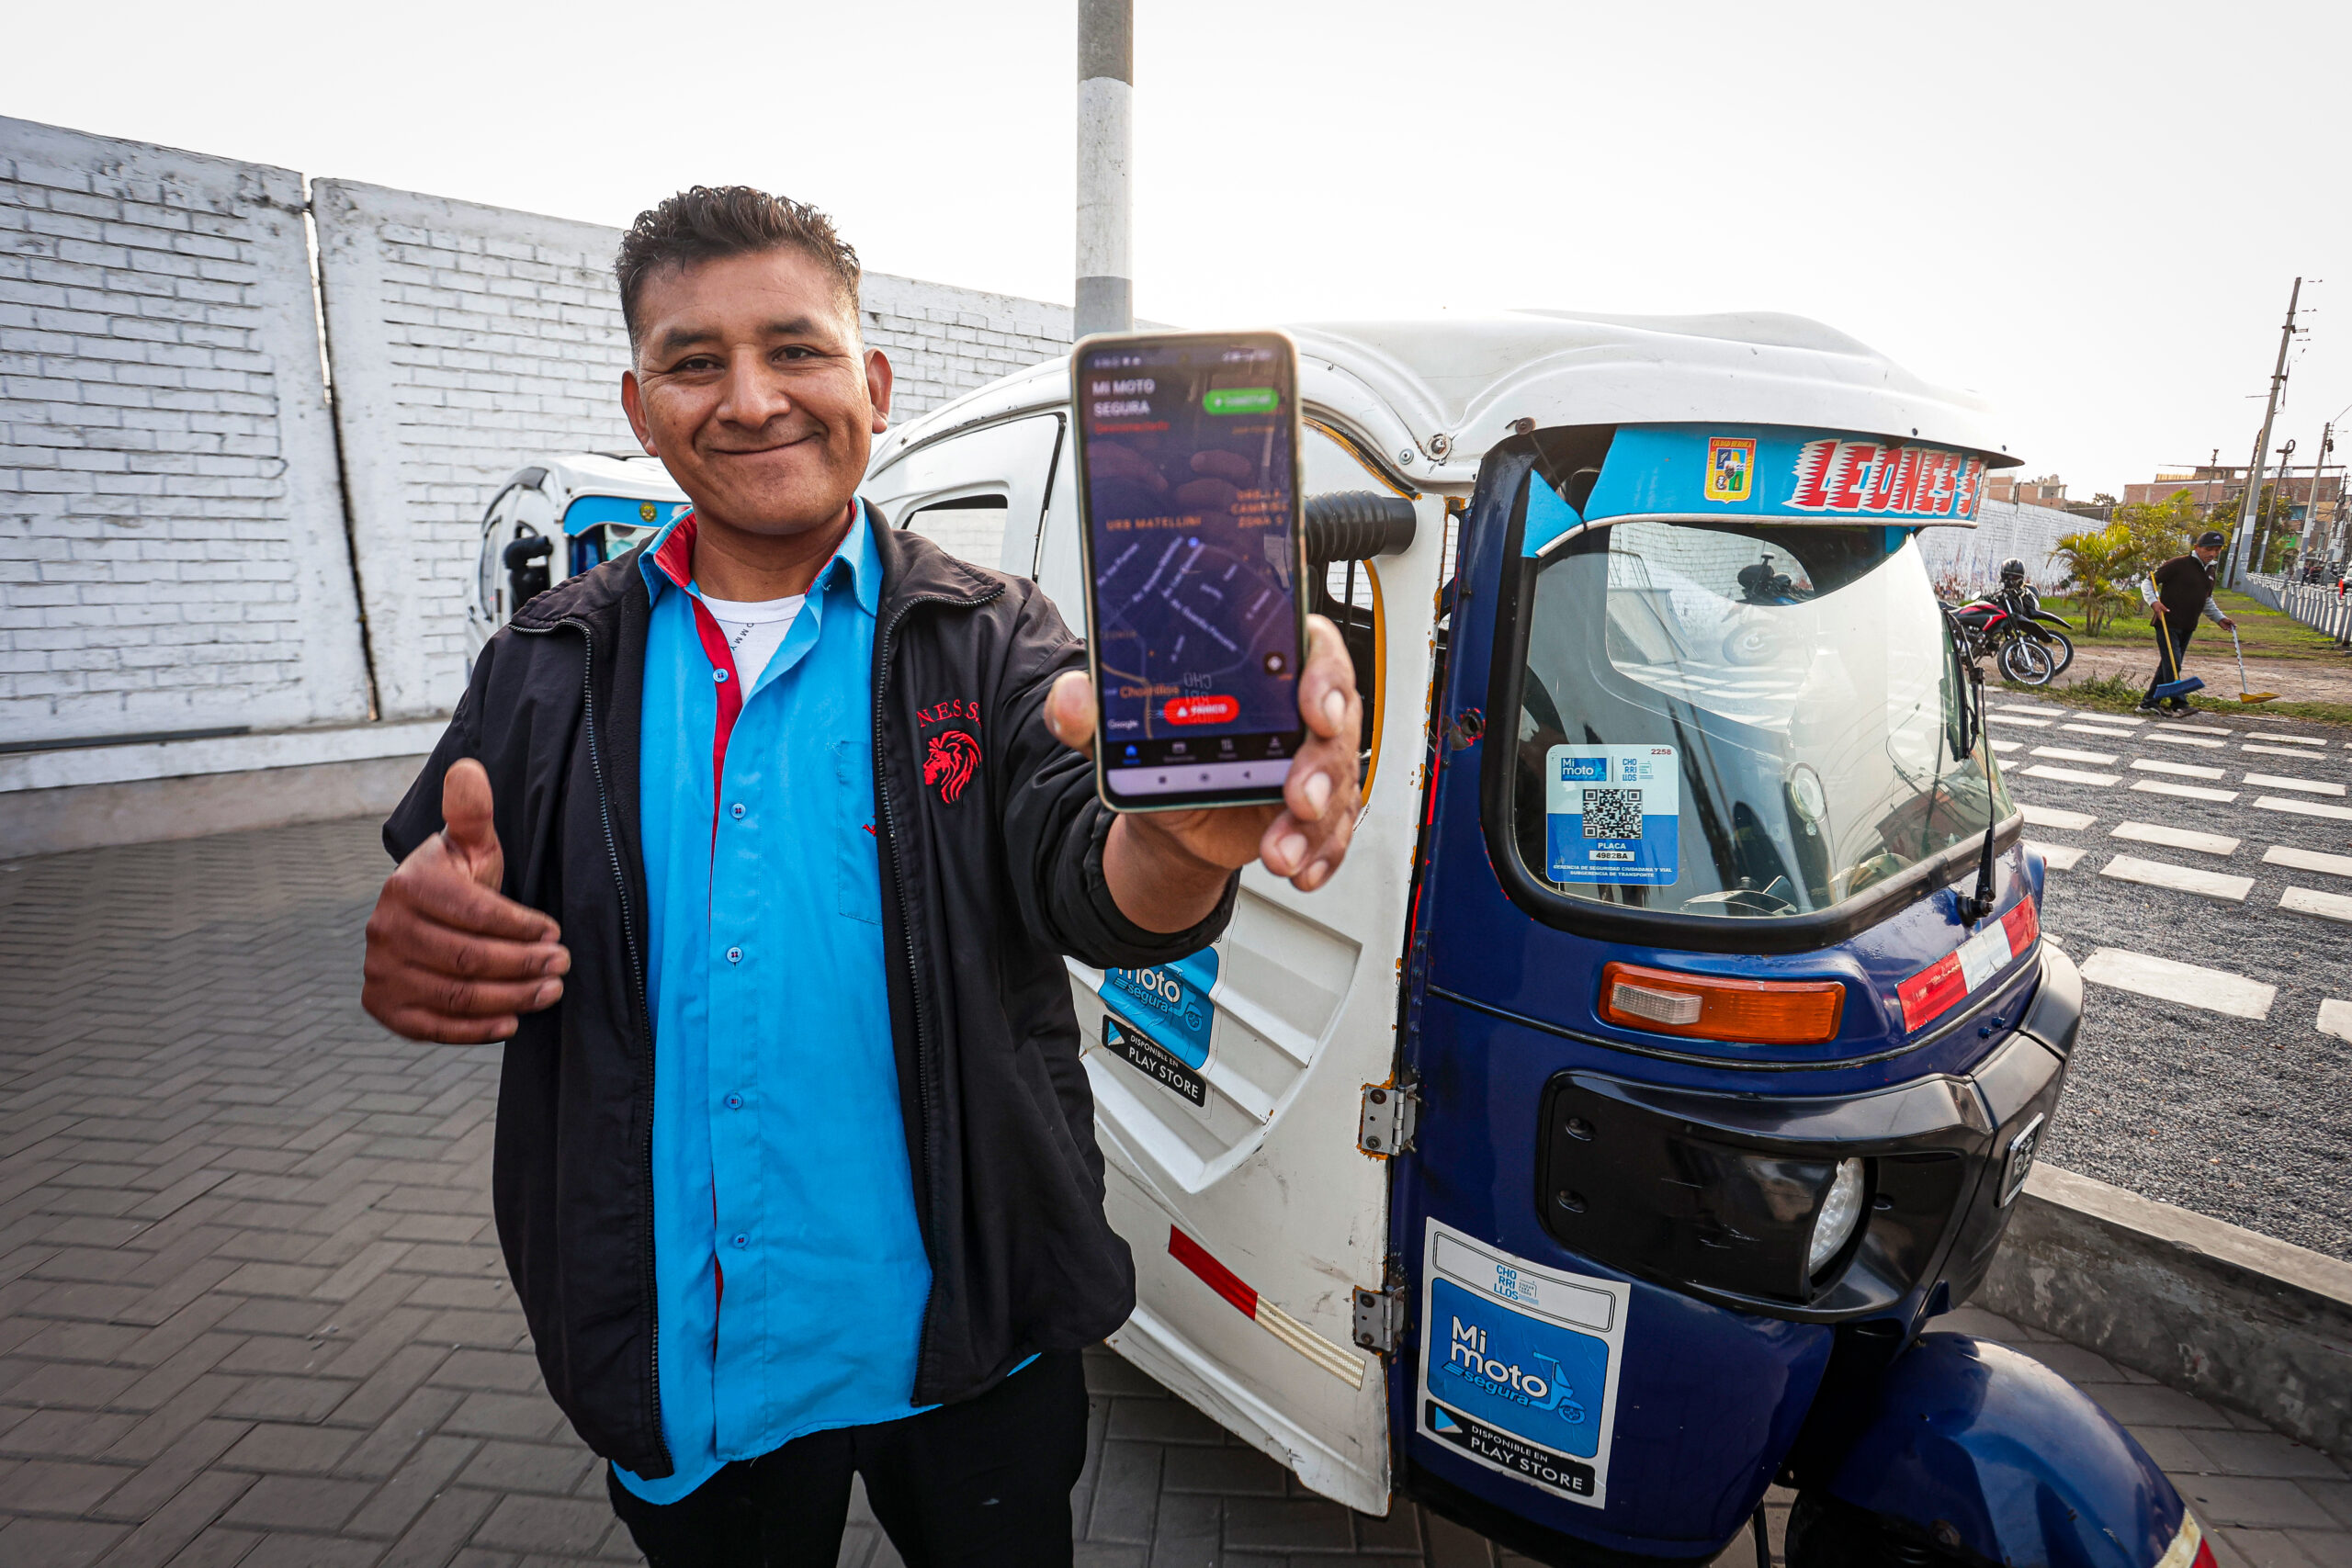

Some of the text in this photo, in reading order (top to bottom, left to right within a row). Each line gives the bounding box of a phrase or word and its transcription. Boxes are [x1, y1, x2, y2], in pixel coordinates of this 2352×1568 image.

[1092, 378, 1155, 396] MI MOTO
[1093, 400, 1150, 417] SEGURA
[1107, 519, 1132, 531] URB
[1107, 718, 1139, 731] Google
[1563, 758, 1575, 767] Mi
[1563, 765, 1594, 775] moto
[1623, 758, 1637, 766] CHO
[1118, 967, 1181, 1003] moto
[1127, 984, 1169, 1013] segura
[1130, 1035, 1179, 1067] DISPONIBLE EN
[1129, 1046, 1199, 1099] PLAY STORE
[1497, 1264, 1517, 1280] CHO
[1494, 1283, 1519, 1300] LLOS
[1498, 1275, 1515, 1290] RRI
[1452, 1315, 1487, 1354] Mi
[1450, 1338, 1548, 1399] moto
[1464, 1370, 1530, 1407] segura
[1472, 1425, 1548, 1463] DISPONIBLE EN
[1471, 1438, 1583, 1491] PLAY STORE
